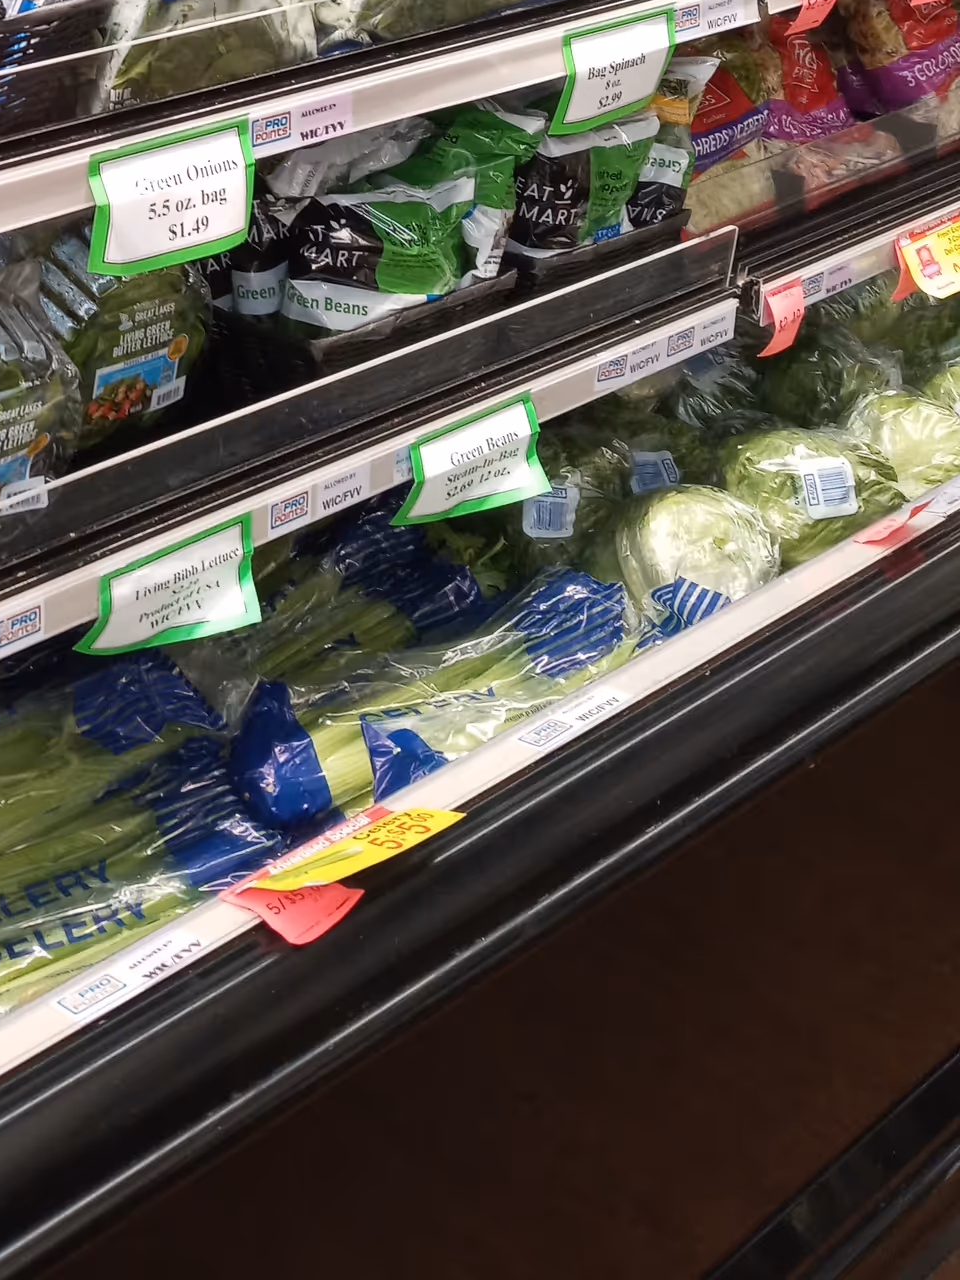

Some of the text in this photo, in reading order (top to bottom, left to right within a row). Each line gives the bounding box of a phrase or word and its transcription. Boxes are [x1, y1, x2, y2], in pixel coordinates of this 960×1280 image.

[680, 7, 698, 20] PRO
[708, 0, 724, 10] ALLOWED
[706, 13, 738, 30] WIC/FVV
[587, 53, 646, 81] Bag Spinach
[604, 79, 622, 91] 8 oz.
[597, 91, 623, 111] $2.99
[264, 116, 288, 130] PRO
[300, 120, 346, 141] WIC/FVV
[254, 127, 288, 142] POINTS
[135, 158, 238, 196] Green Onions
[515, 176, 554, 202] EAT
[148, 187, 228, 221] 5.5 oz. bag
[168, 215, 209, 241] $1.49
[237, 282, 276, 301] Green
[287, 286, 369, 317] Green Beans
[155, 302, 176, 315] LAKES
[112, 328, 175, 358] BUTTER LETTUCE
[120, 320, 171, 345] LIVING GREEN
[676, 331, 692, 343] PRO
[700, 328, 729, 347] WIC/FVV
[608, 357, 626, 369] PRO
[629, 352, 661, 373] WIC/FVV
[20, 401, 43, 417] LAKES
[3, 428, 38, 449] LETTUCE
[8, 420, 36, 438] GREEN
[450, 431, 520, 468] Green Beans
[444, 447, 520, 486] Steam-In-Bag
[479, 470, 492, 484] 12
[493, 467, 511, 478] oz.
[324, 472, 356, 491] ALLOWED BY
[283, 495, 306, 513] PRO
[322, 485, 363, 512] WIC/FVV
[135, 579, 170, 601] Living
[173, 565, 199, 585] Bibb
[201, 547, 240, 572] Lettuce
[10, 608, 38, 630] PRO
[326, 814, 373, 843] Special
[351, 811, 412, 841] Celery
[77, 977, 112, 999] PRO
